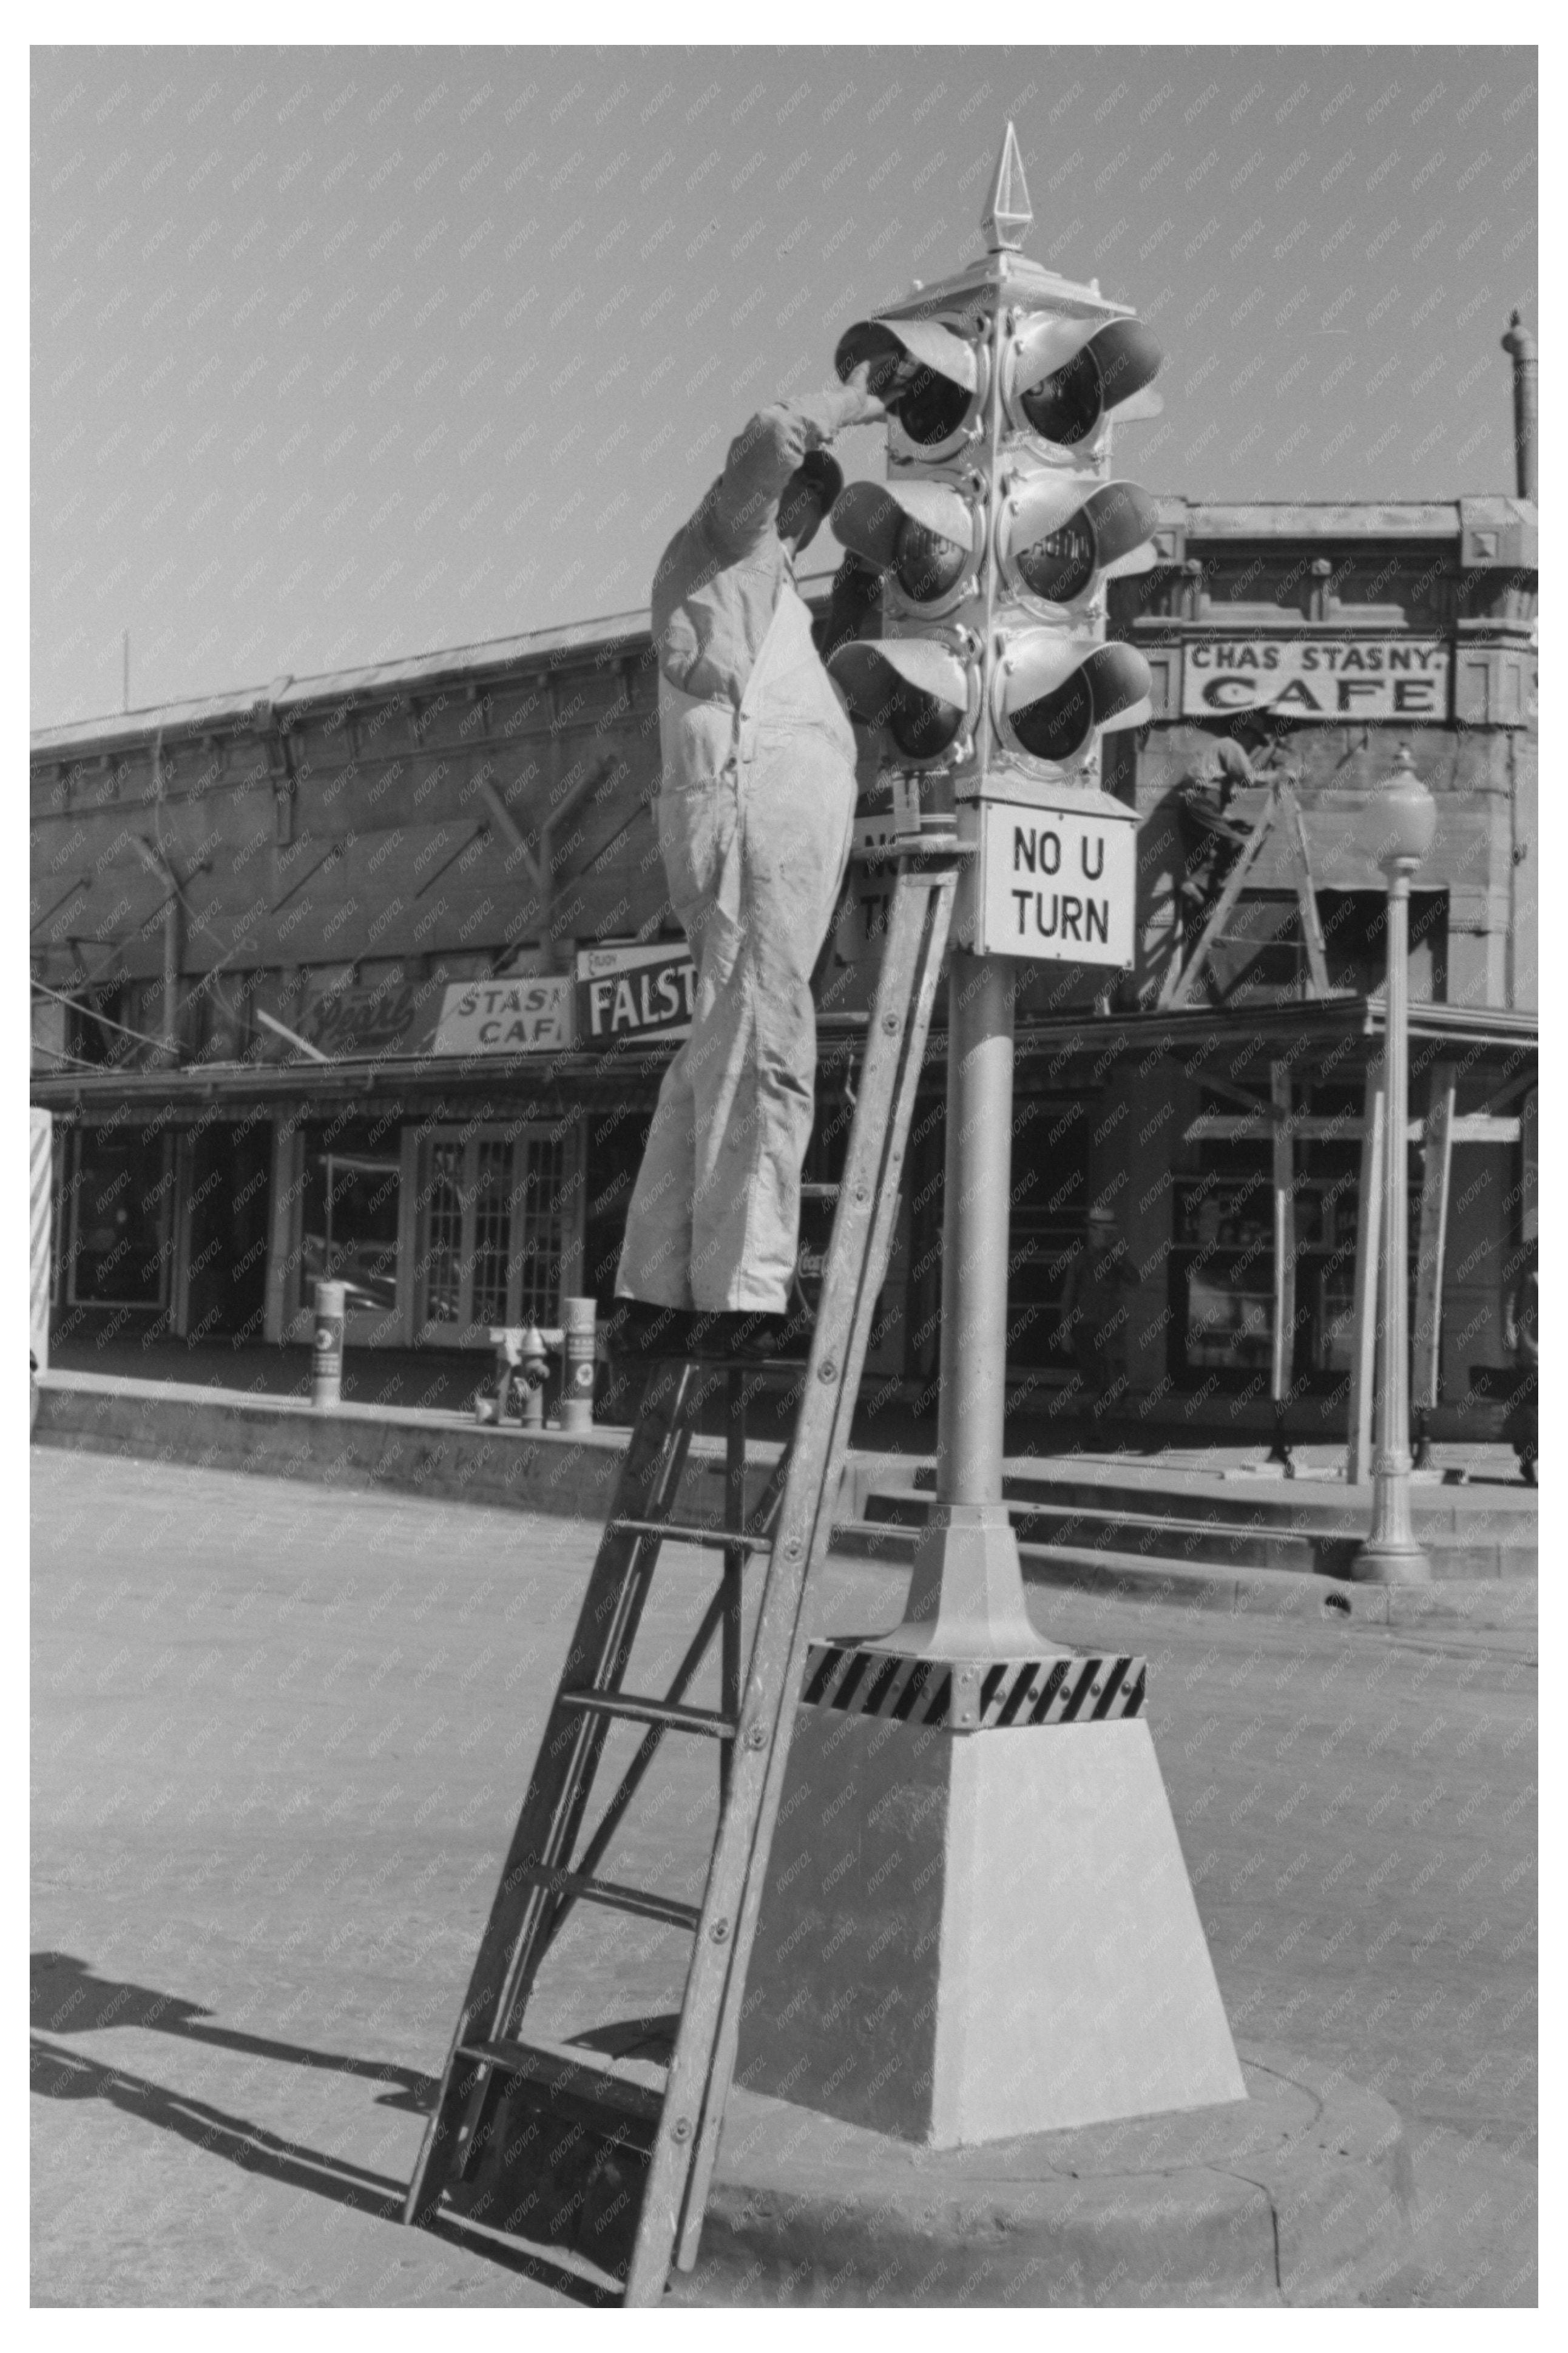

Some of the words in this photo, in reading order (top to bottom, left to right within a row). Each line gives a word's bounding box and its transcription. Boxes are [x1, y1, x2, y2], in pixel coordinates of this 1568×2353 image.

[1192, 646, 1279, 669] CHAS
[1202, 676, 1435, 712] CAFE
[1014, 826, 1061, 875] NO
[1081, 835, 1104, 880] U
[1012, 889, 1109, 944] TURN
